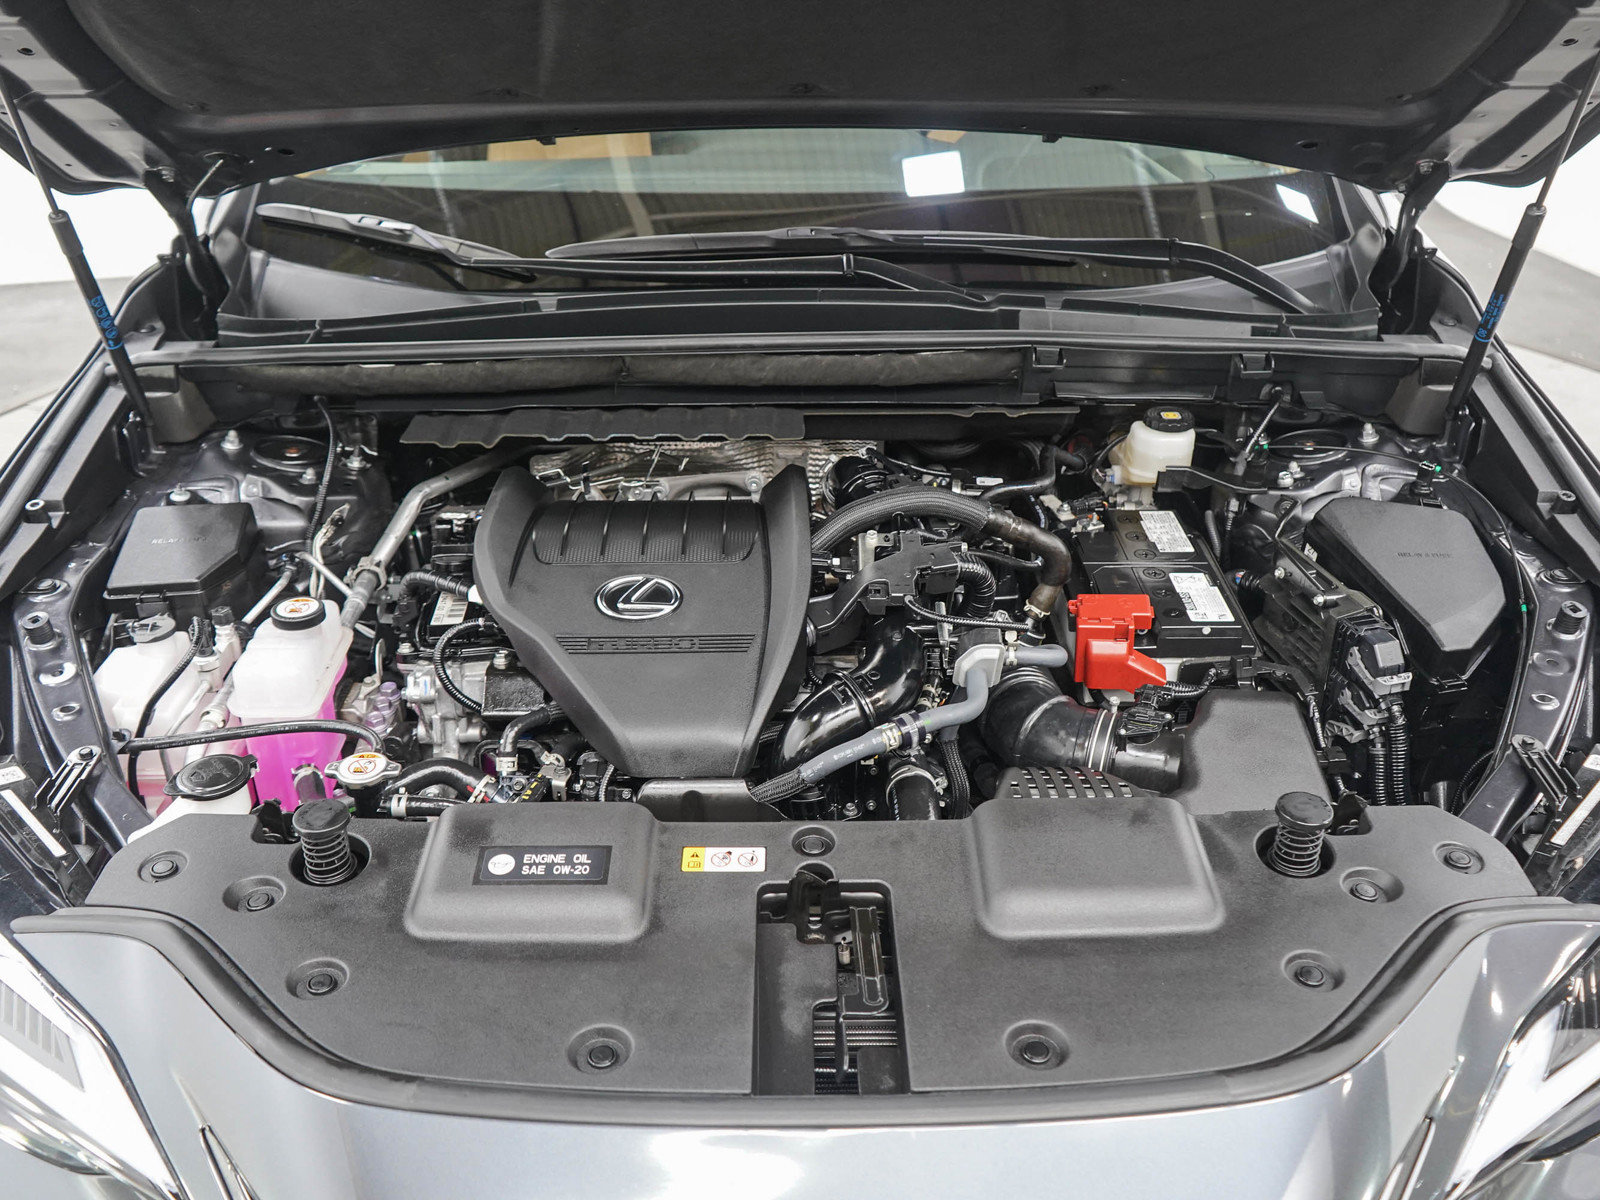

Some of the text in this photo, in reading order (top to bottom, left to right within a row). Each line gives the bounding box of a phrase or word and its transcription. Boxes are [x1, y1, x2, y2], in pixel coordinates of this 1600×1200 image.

[588, 637, 697, 650] TURBO
[523, 854, 591, 864] ENGINE OIL
[521, 865, 590, 874] SAE 0W-20
